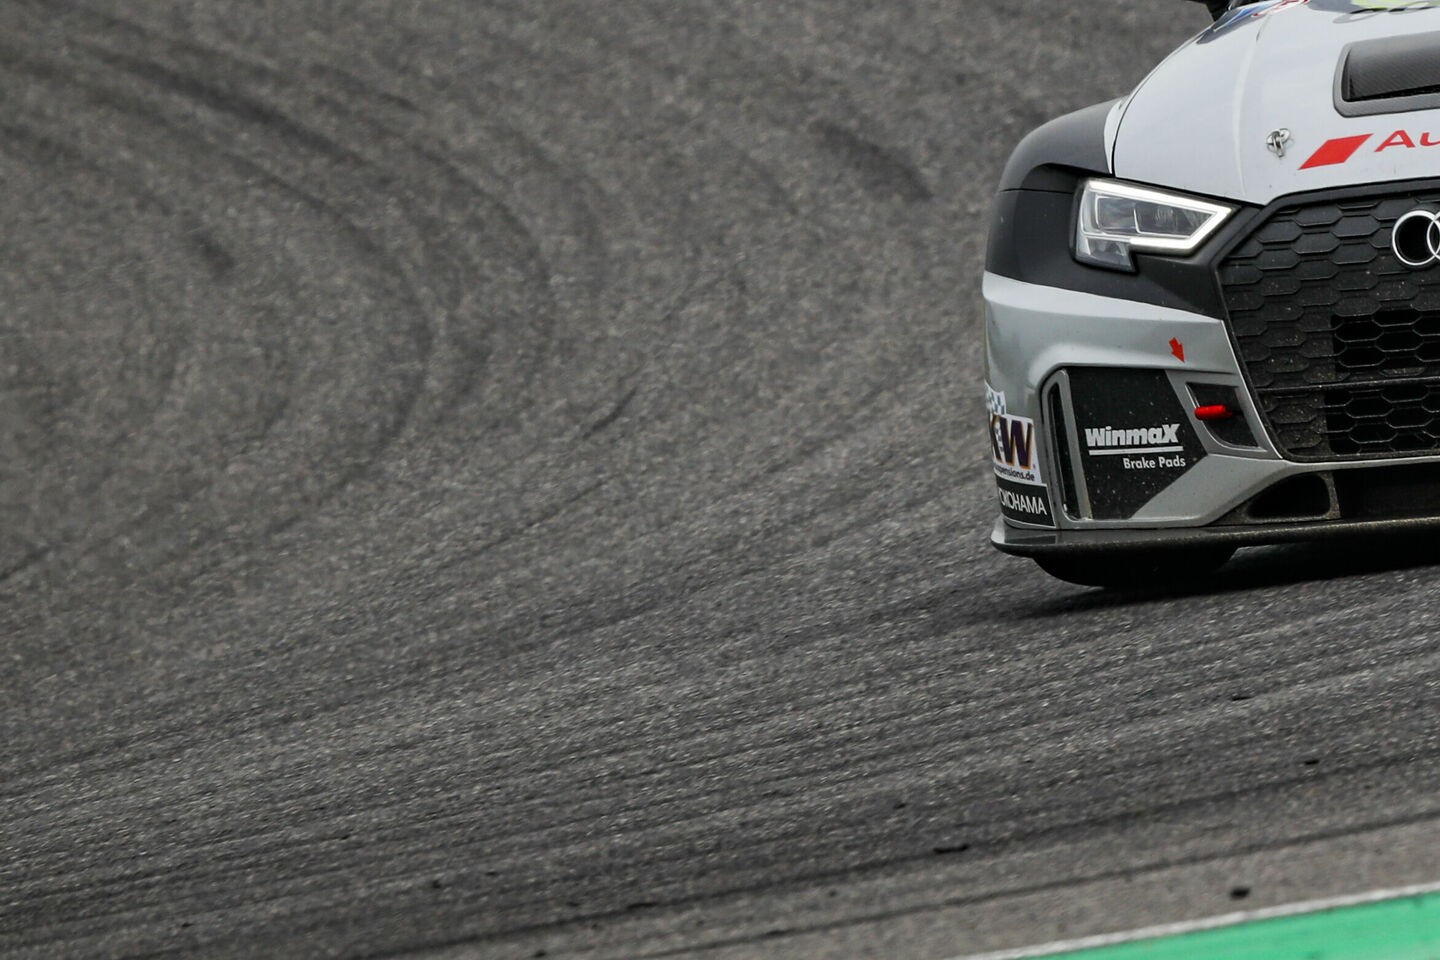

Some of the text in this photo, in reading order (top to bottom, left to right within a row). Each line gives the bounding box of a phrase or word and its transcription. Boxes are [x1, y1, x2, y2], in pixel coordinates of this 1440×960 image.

[1122, 455, 1186, 469] Brake Pads
[999, 486, 1048, 516] OKOHAMA
